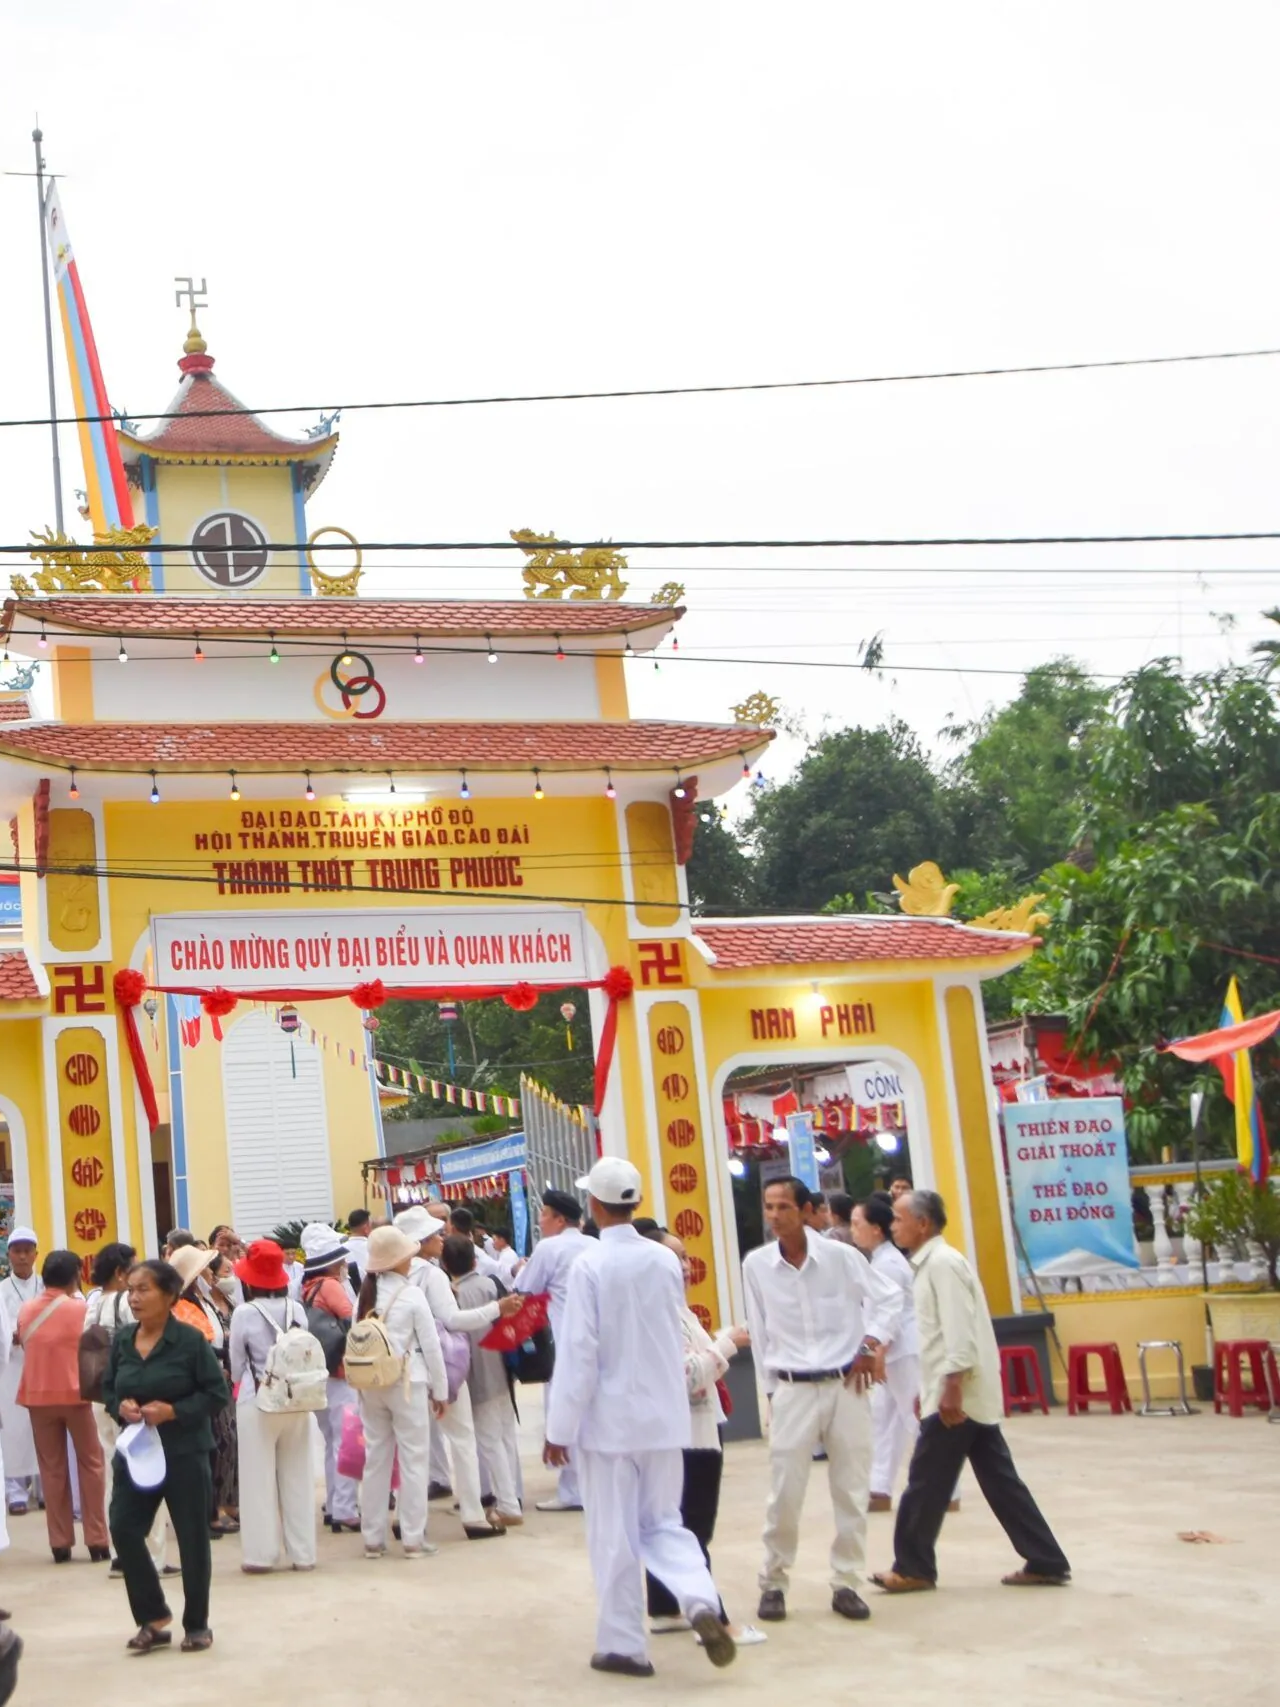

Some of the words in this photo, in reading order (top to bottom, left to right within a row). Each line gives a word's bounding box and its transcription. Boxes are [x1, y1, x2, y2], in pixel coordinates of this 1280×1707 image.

[195, 830, 232, 852] HỘI
[454, 828, 490, 844] CAO
[212, 859, 290, 895] THÁNH
[297, 855, 354, 892] THẤT
[366, 858, 441, 889] TRUNG
[170, 934, 225, 971] CHÀO
[230, 933, 290, 969] MỪNG
[295, 932, 331, 971] QUÝ
[337, 937, 371, 973] ĐẠI
[375, 924, 420, 966] BIỂU
[424, 930, 450, 965] VÀ
[454, 936, 504, 968] QUAN
[508, 928, 572, 963] KHÁCH
[750, 1008, 796, 1040] NAM
[65, 1053, 99, 1086] CAO
[1074, 1118, 1112, 1137] ĐẠO
[1060, 1139, 1116, 1158] THOÁT
[1032, 1178, 1068, 1198] THẾ
[1072, 1181, 1108, 1200] ĐẠO
[1030, 1207, 1062, 1225] ĐẠI
